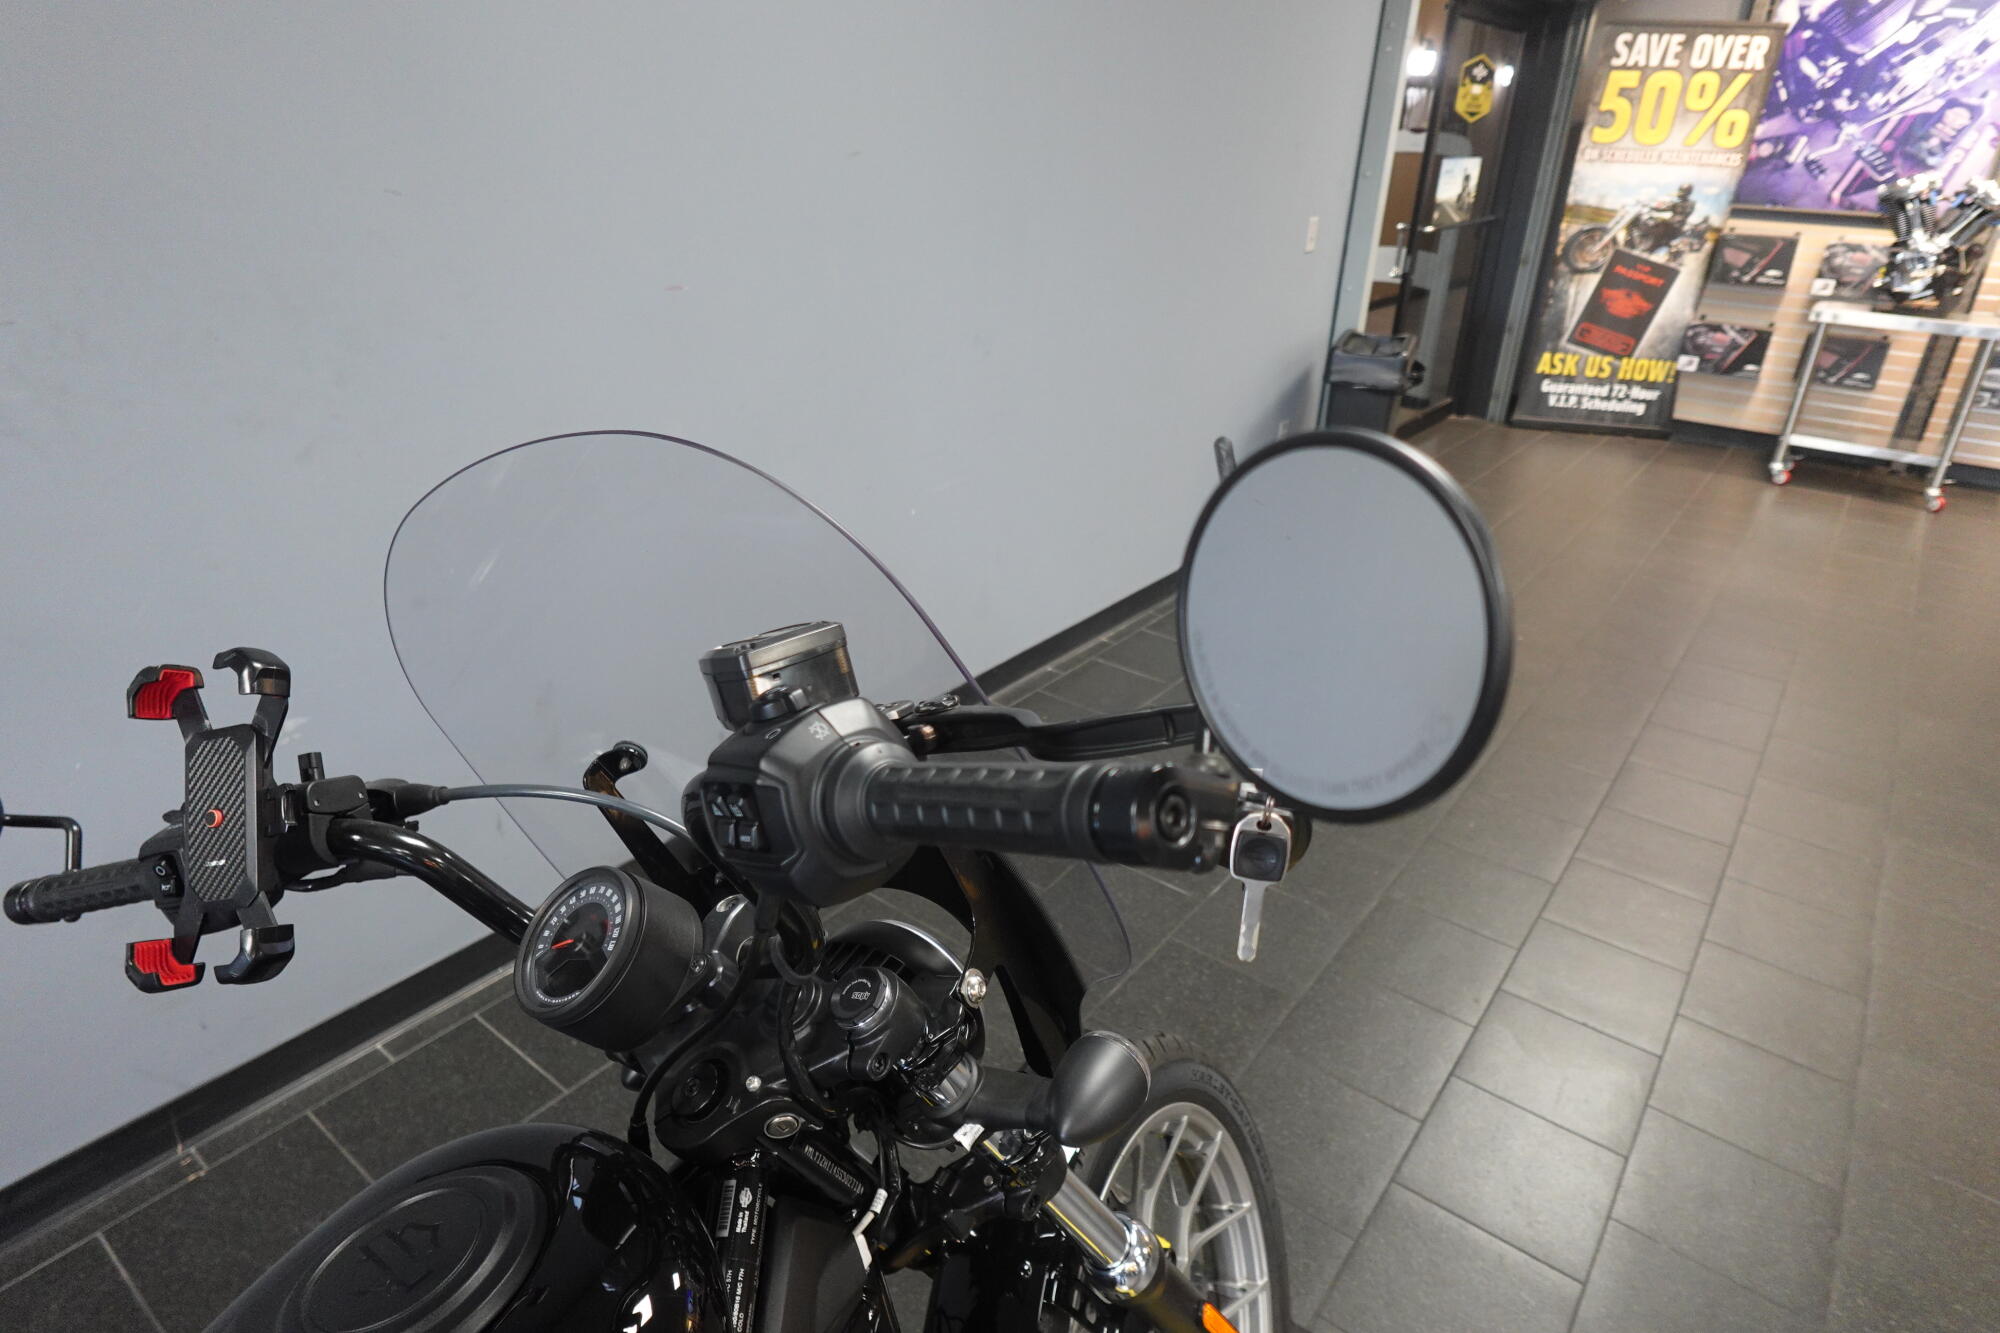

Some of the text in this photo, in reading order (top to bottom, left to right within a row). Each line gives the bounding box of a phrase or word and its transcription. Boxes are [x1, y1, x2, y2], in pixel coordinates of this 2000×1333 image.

[1610, 32, 1771, 70] SAVE OVER
[1590, 69, 1753, 149] 50%
[1535, 352, 1678, 384] ASK US HOW!
[1540, 378, 1663, 401] Guaranteed 72-Hour
[1581, 396, 1647, 417] Scheduling
[753, 1183, 763, 1226] MOTORCYCLE
[735, 1218, 743, 1233] Made
[741, 1210, 750, 1233] Thailand
